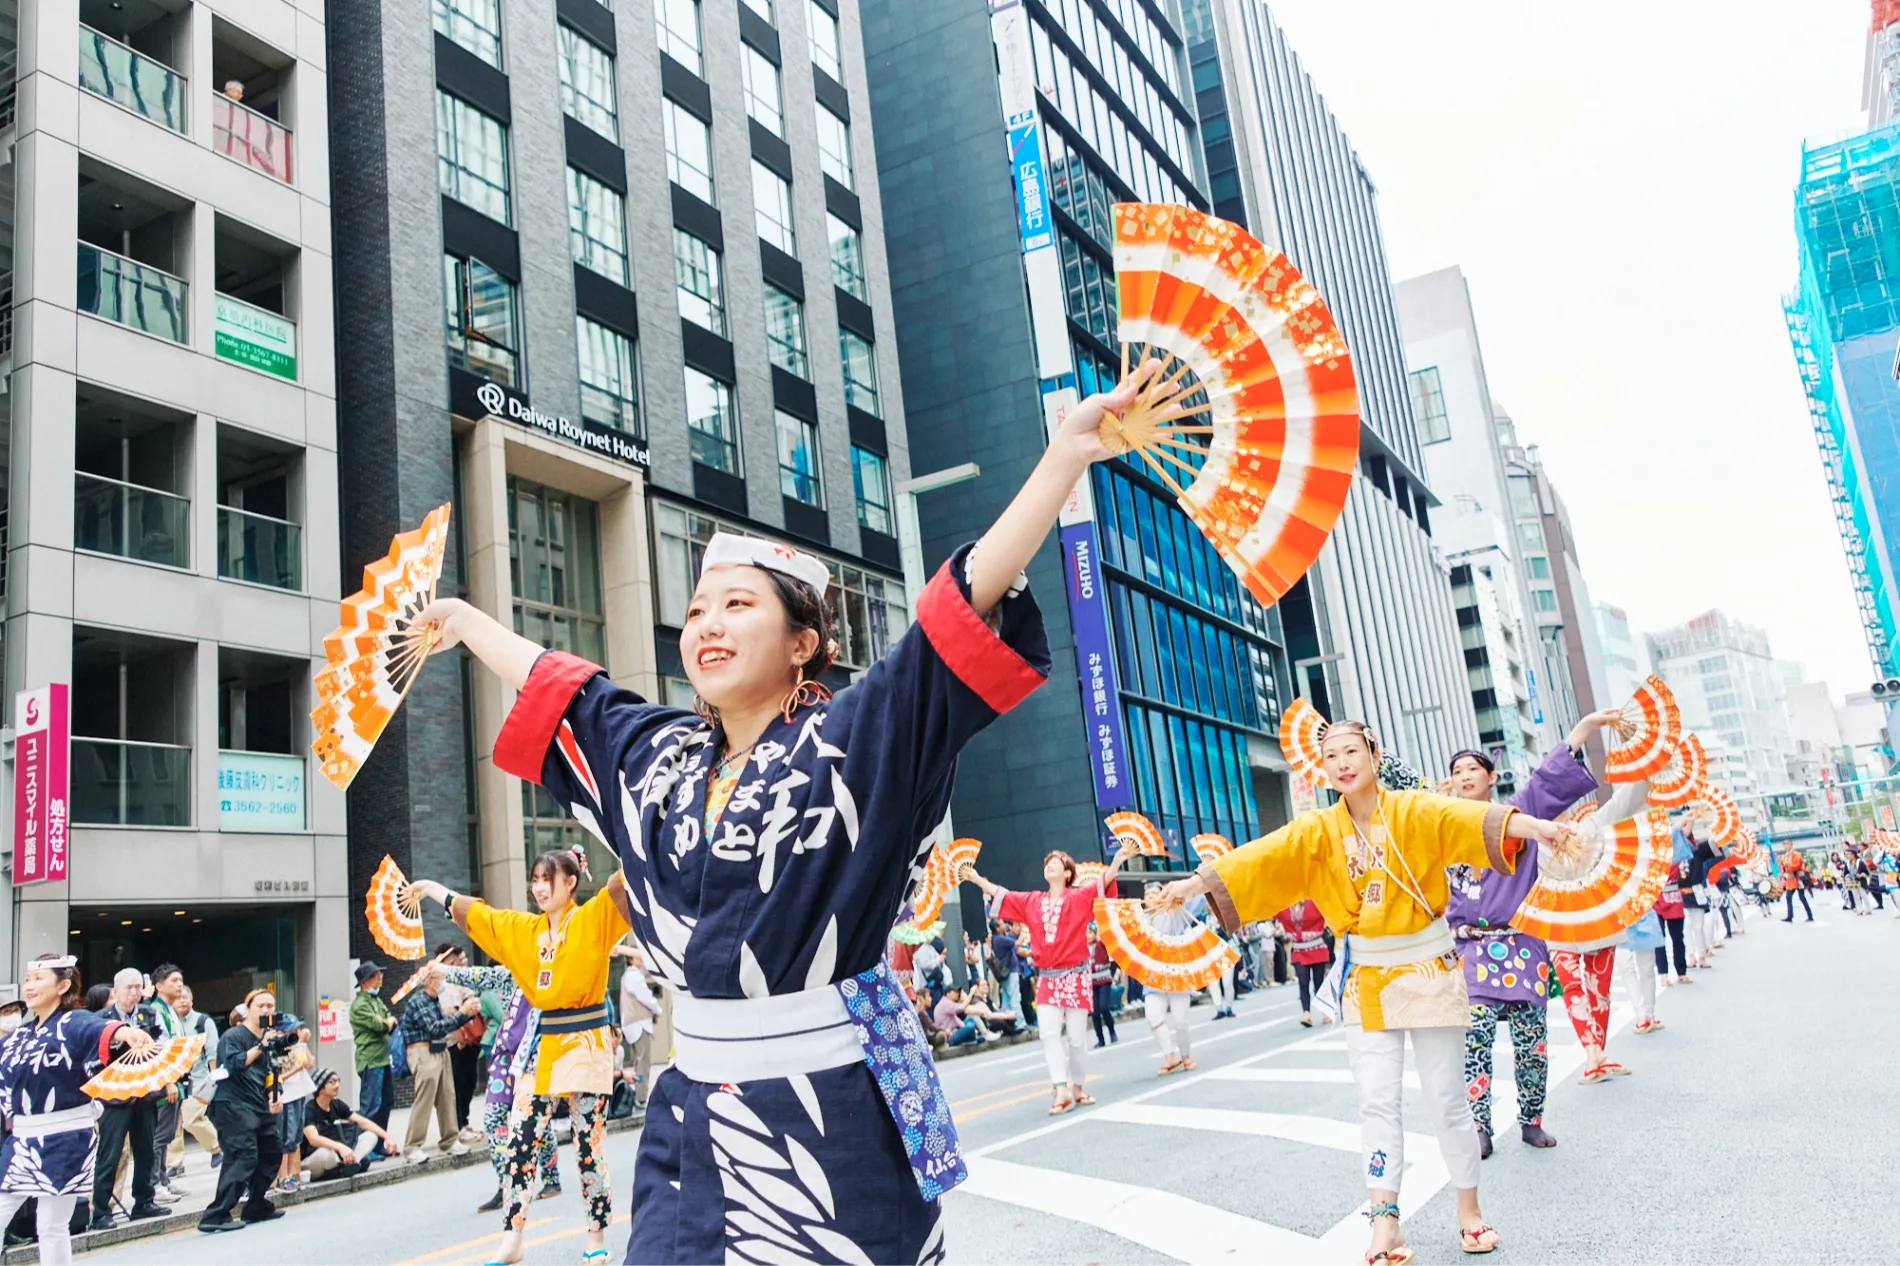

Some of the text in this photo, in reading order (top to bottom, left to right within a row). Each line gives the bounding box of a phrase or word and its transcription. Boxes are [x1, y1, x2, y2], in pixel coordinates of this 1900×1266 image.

[1021, 161, 1044, 229] 広島銀行
[508, 397, 650, 465] Daiwa Roynet Hotel
[1075, 540, 1094, 599] MIZUHO
[1088, 653, 1108, 716] みずほ銀行
[1098, 724, 1118, 788] みずほ証券
[24, 737, 38, 876] ユニスマイル薬局
[49, 798, 65, 872] 処方せん
[711, 740, 786, 862] やまと
